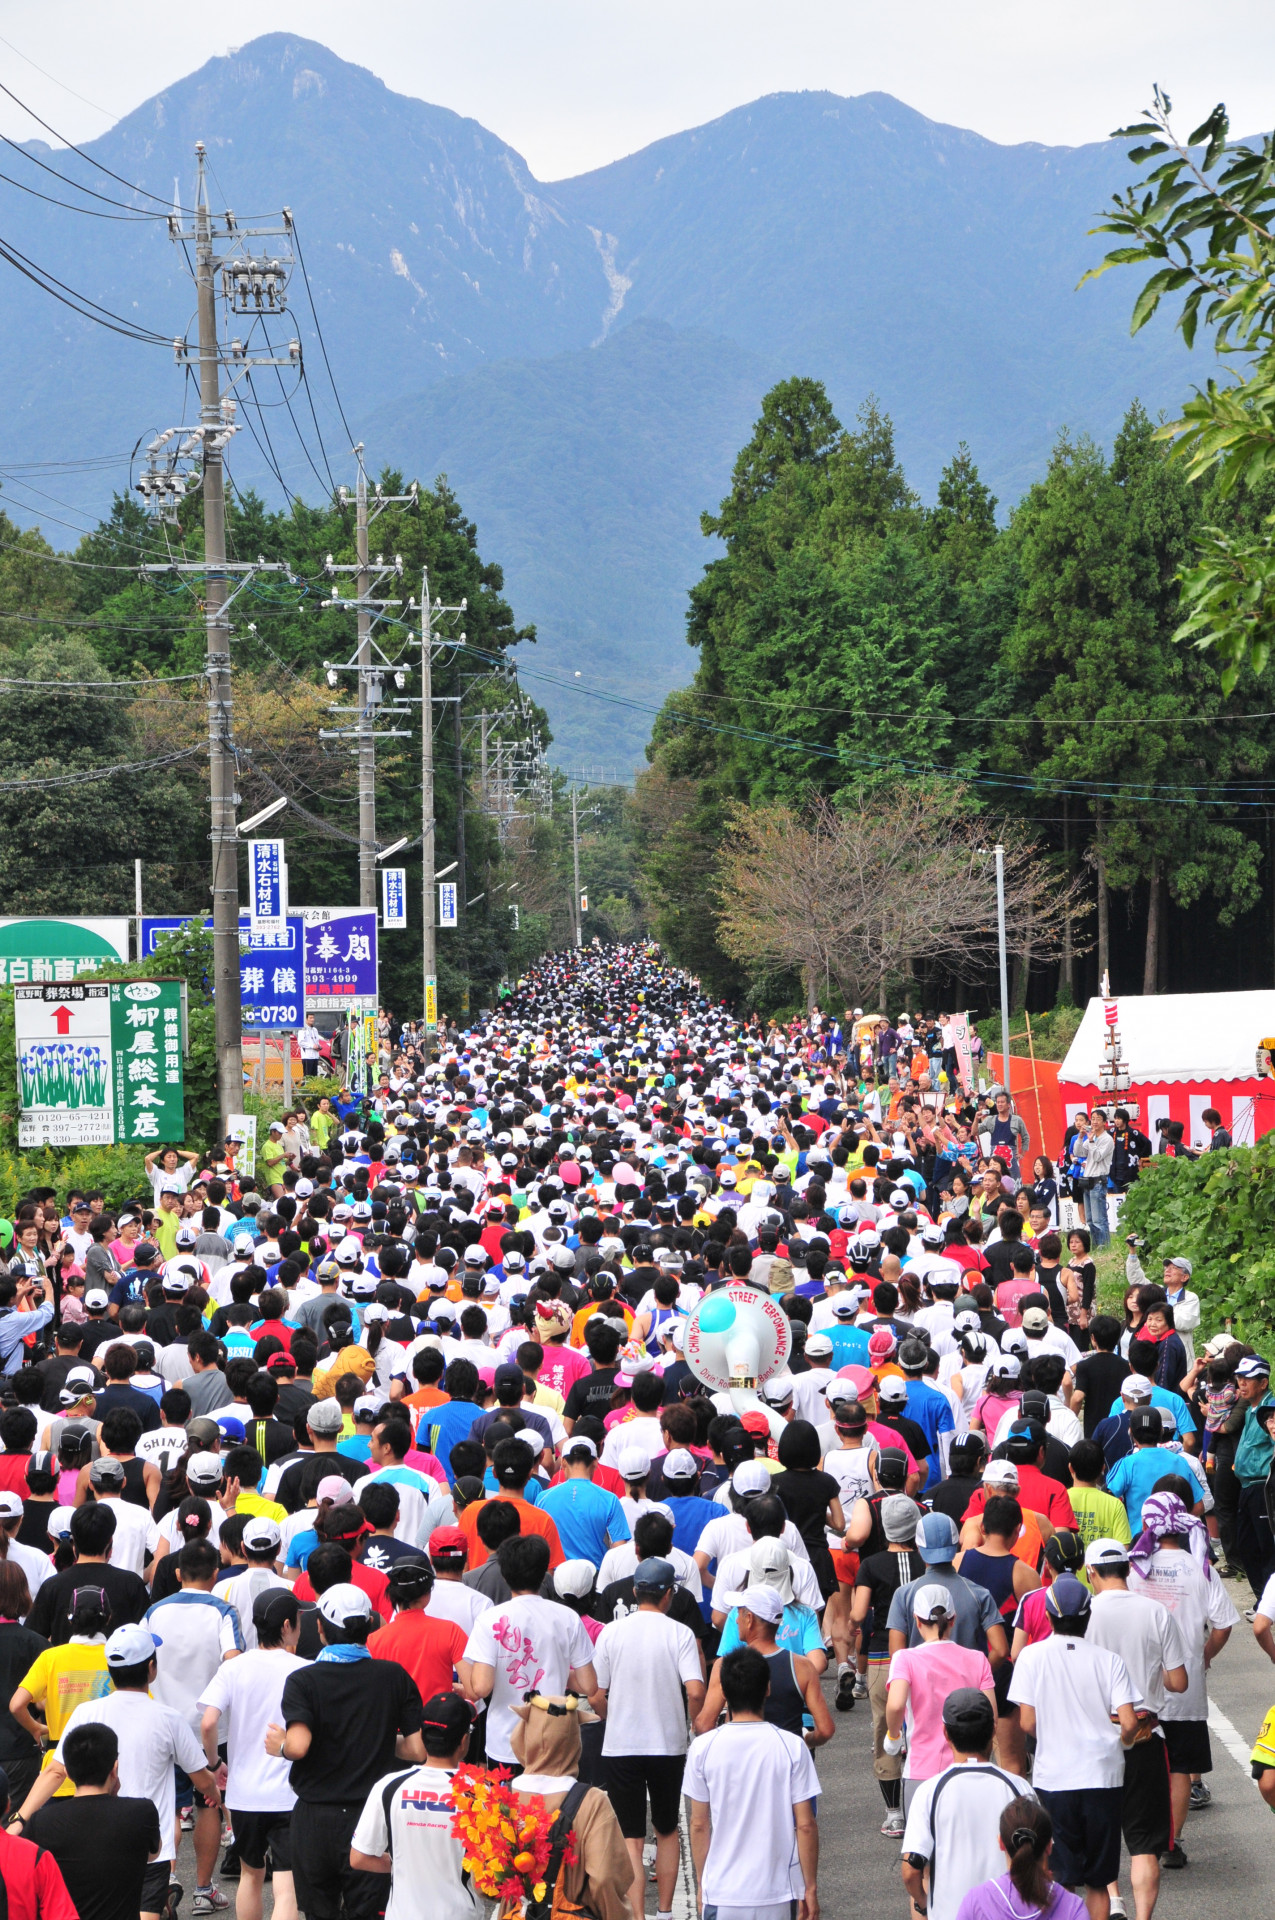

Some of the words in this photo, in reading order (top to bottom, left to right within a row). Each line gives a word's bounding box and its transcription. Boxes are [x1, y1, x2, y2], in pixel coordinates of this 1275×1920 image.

[257, 845, 272, 915] 清水石材店
[388, 872, 398, 917] 清水石材店
[443, 886, 451, 918] 清水石材店
[45, 986, 84, 1000] 葬祭場
[88, 988, 106, 997] 指定
[240, 967, 297, 994] 葬儀
[163, 1007, 180, 1084] 葬儀御用達
[955, 1026, 974, 1091] ジュース
[124, 1003, 165, 1138] 柳屋総本店
[38, 1113, 111, 1122] 0120-65-4211
[729, 1291, 758, 1305] STREET
[761, 1301, 787, 1357] PERFORMANCE
[759, 1367, 775, 1383] Band
[401, 1789, 457, 1814] HRC
